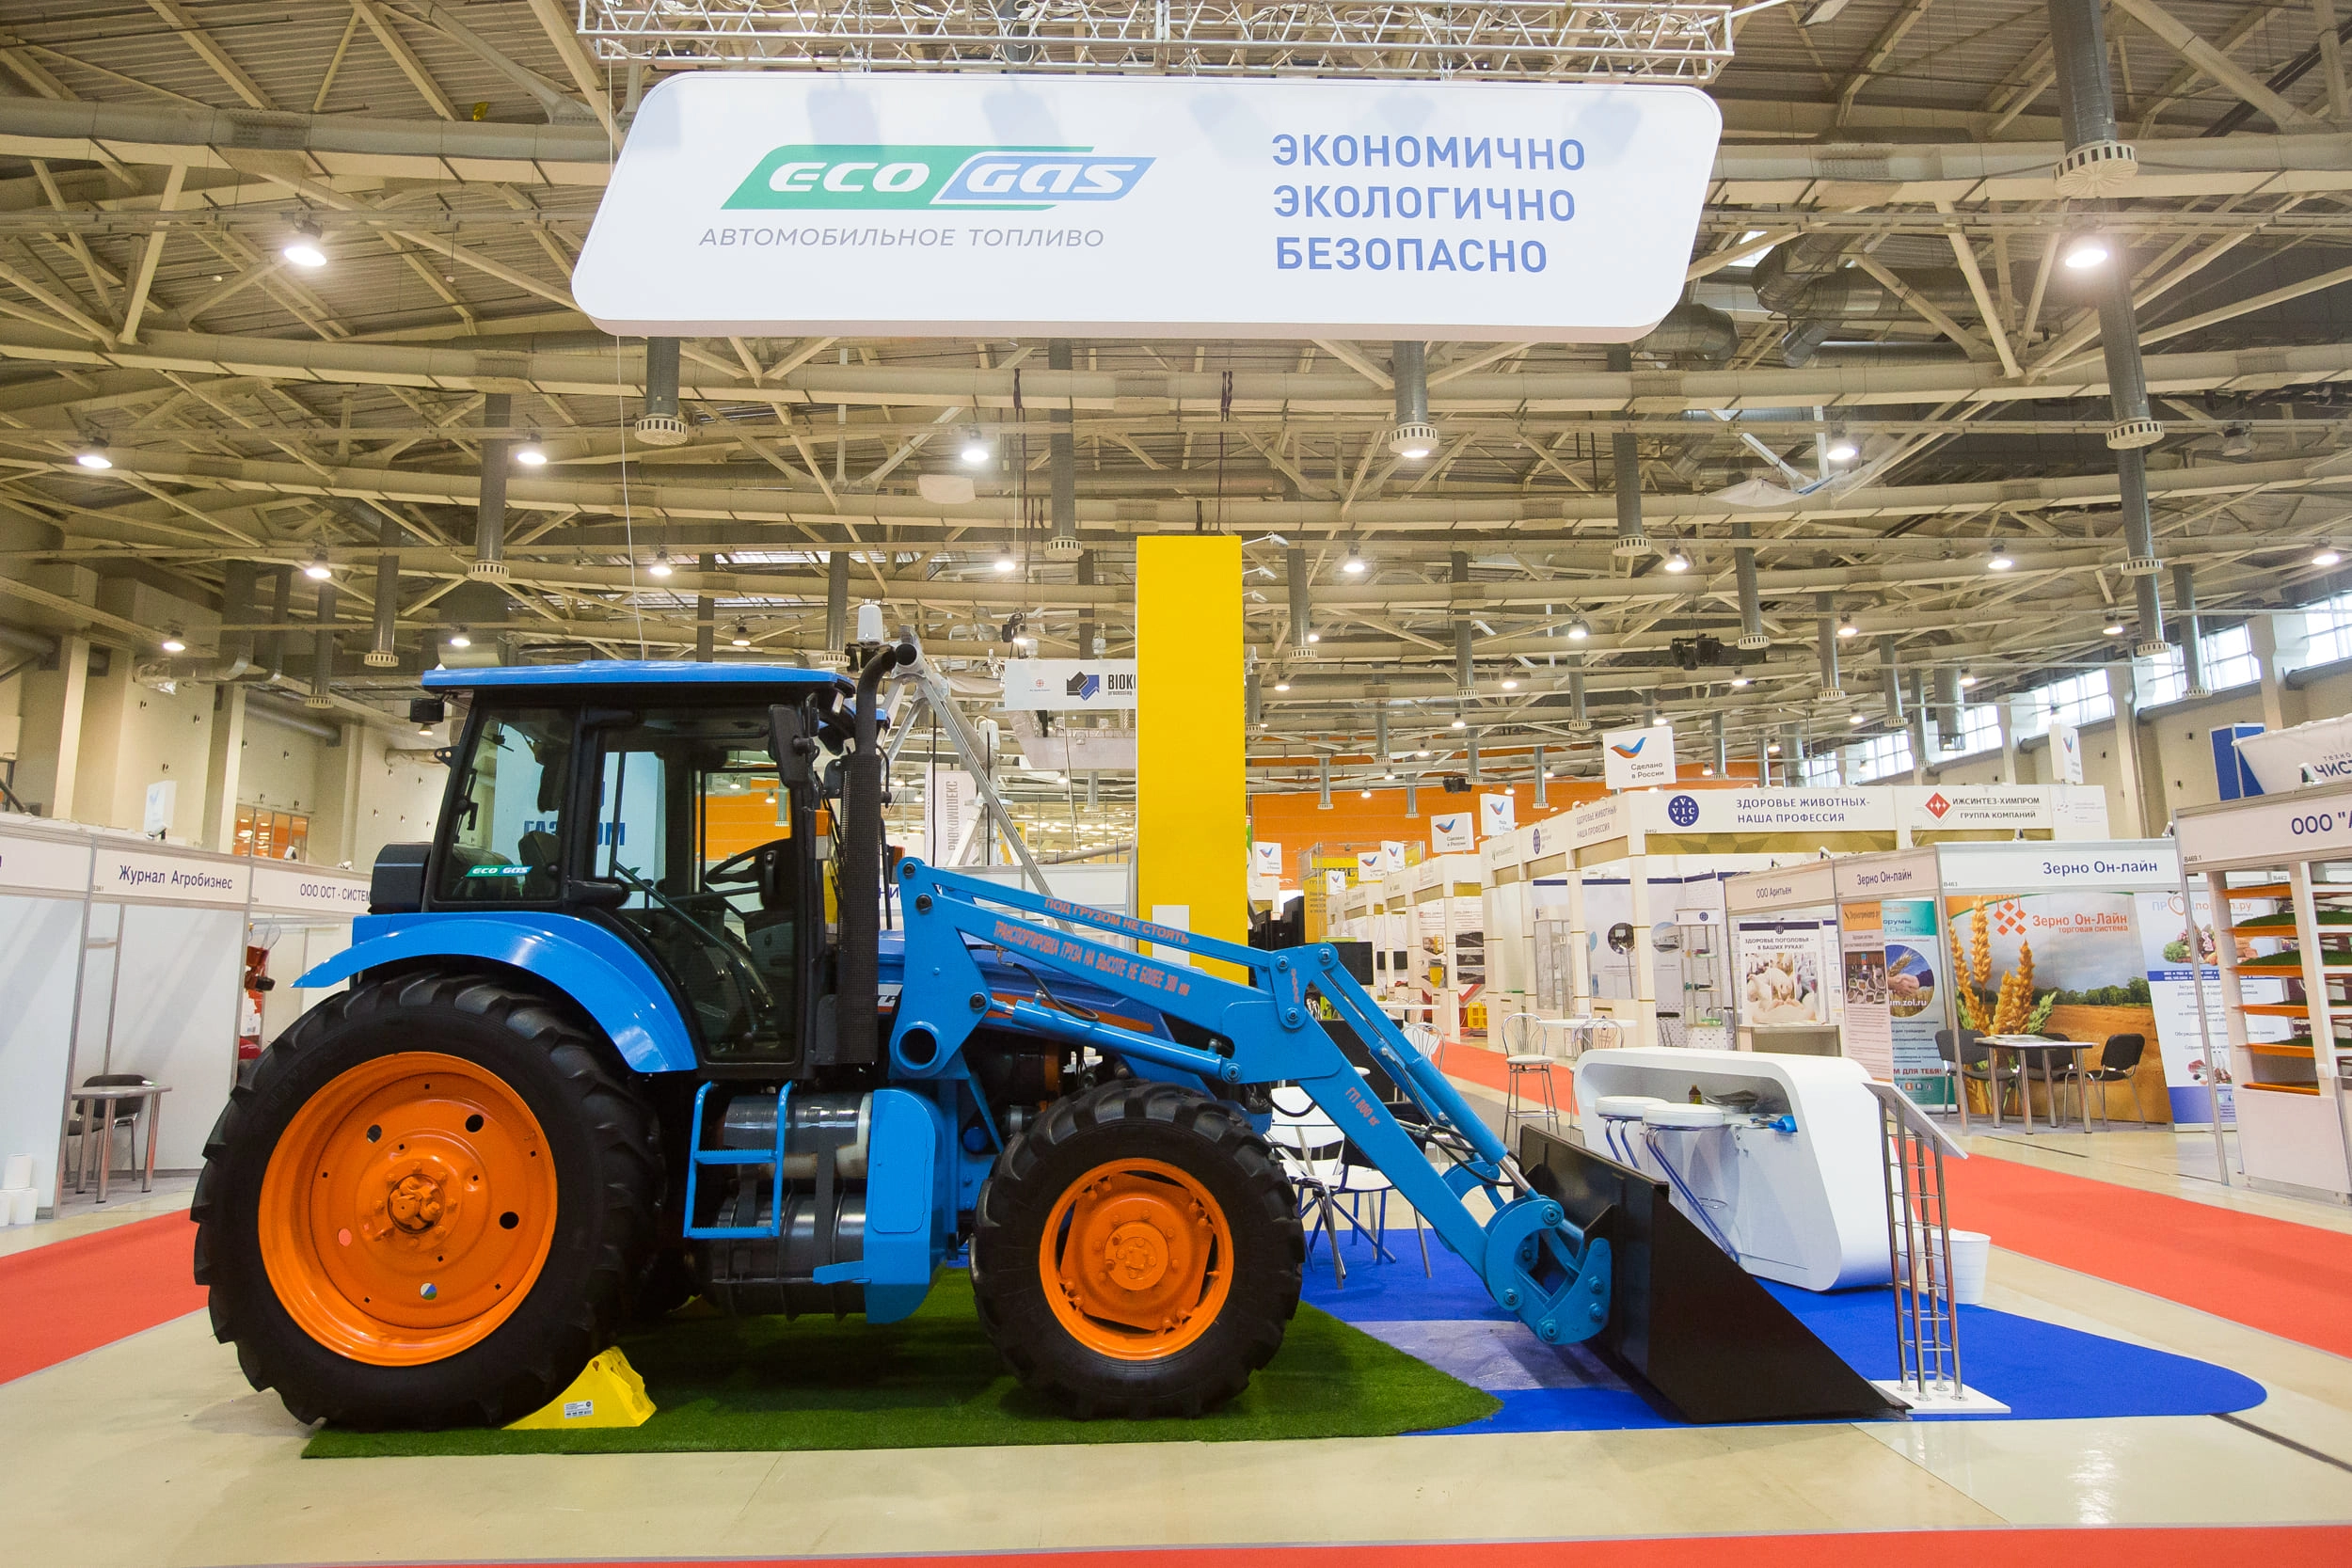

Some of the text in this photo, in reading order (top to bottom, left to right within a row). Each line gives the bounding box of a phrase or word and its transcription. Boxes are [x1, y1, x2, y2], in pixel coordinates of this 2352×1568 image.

[1272, 134, 1585, 170] ЭКОНОМИЧНО
[769, 162, 930, 193] ECO
[1273, 185, 1575, 222] ЭКОЛОГИЧНО
[699, 228, 1104, 247] АВТОМОБИЛЬНОЕ ТОПЛИВО
[1276, 236, 1547, 273] БЕЗОПАСНО
[1631, 762, 1662, 770] Сделано
[1737, 799, 1796, 809] ЗДОРОВЬЕ
[1952, 797, 2040, 805] ИЖСИНТЕЗ-ХИМПРОМ
[1738, 813, 1845, 823] НАША ПРОФЕССИЯ
[1992, 810, 2036, 818] КОМПАНИЙ
[2291, 814, 2332, 834] ООО
[119, 865, 232, 890] Журнал Агробизнес
[2042, 860, 2157, 877] Зерно Он-лайн
[1857, 869, 1912, 887] Зерно Он-лайн
[300, 883, 318, 896] ООО
[321, 885, 336, 898] ОСТ
[1044, 898, 1189, 944] ПОД ГРУЗОМ НЕ СТОЯТЬ
[2033, 912, 2127, 927] Зерно Он-Лайн
[993, 921, 1059, 955] ТРАНСПОРТИРОВКА
[1083, 948, 1095, 967] НА
[1096, 953, 1127, 977] ВЫСОТЕ
[1127, 963, 1139, 980] НЕ
[1138, 966, 1165, 988] БОЛЕЕ
